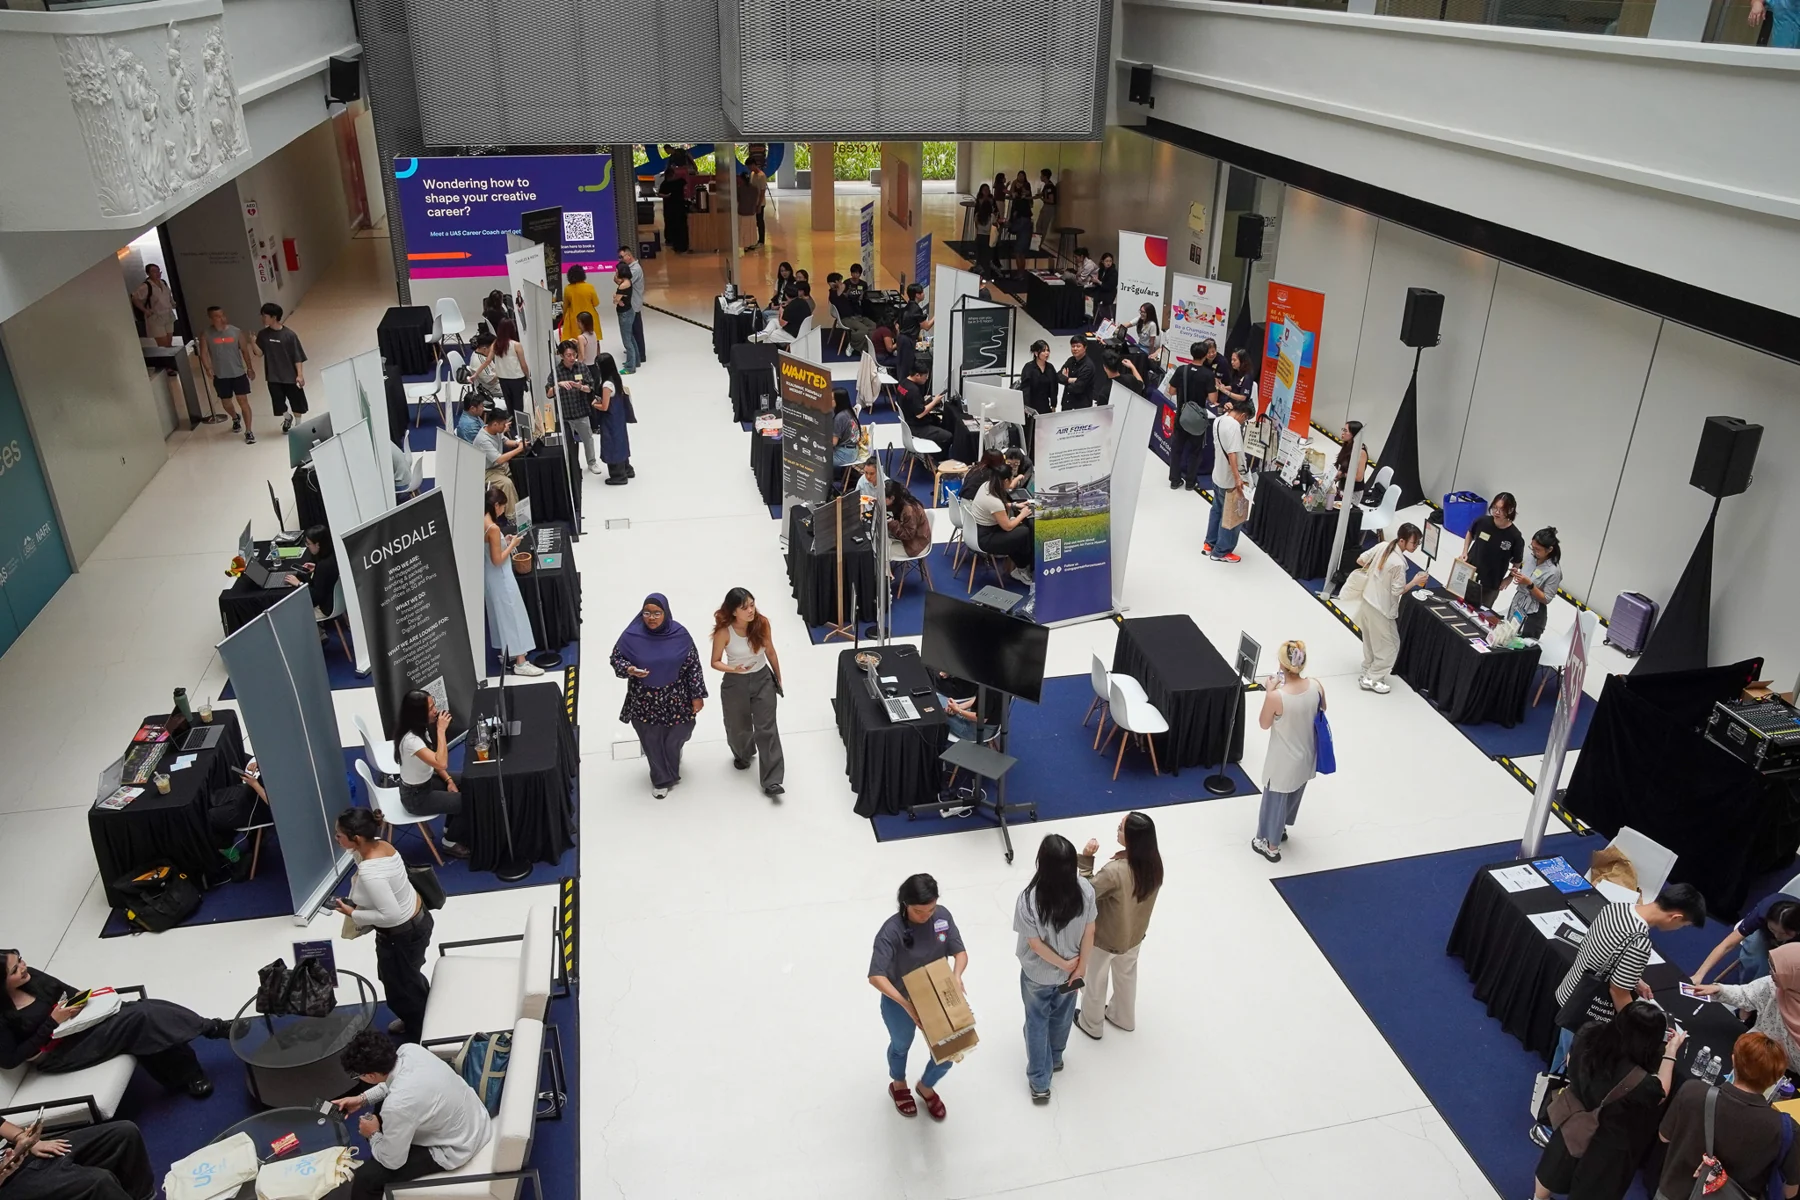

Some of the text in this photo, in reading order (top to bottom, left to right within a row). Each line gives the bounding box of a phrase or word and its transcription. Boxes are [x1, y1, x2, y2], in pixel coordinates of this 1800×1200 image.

[423, 177, 530, 190] Wondering how to
[425, 190, 536, 204] shape your creative
[427, 206, 471, 217] career?
[1186, 326, 1210, 335] Champion
[782, 362, 827, 388] WANTED
[363, 520, 437, 570] LONSDALE
[388, 565, 401, 575] WHO
[395, 561, 422, 578] independent
[408, 564, 429, 579] packaging
[393, 582, 408, 593] design
[395, 600, 409, 611] WHAT
[396, 612, 414, 624] Creative
[388, 644, 400, 656] WHAT
[400, 640, 408, 648] WE
[409, 634, 419, 643] ARE
[419, 622, 438, 638] LOOKING
